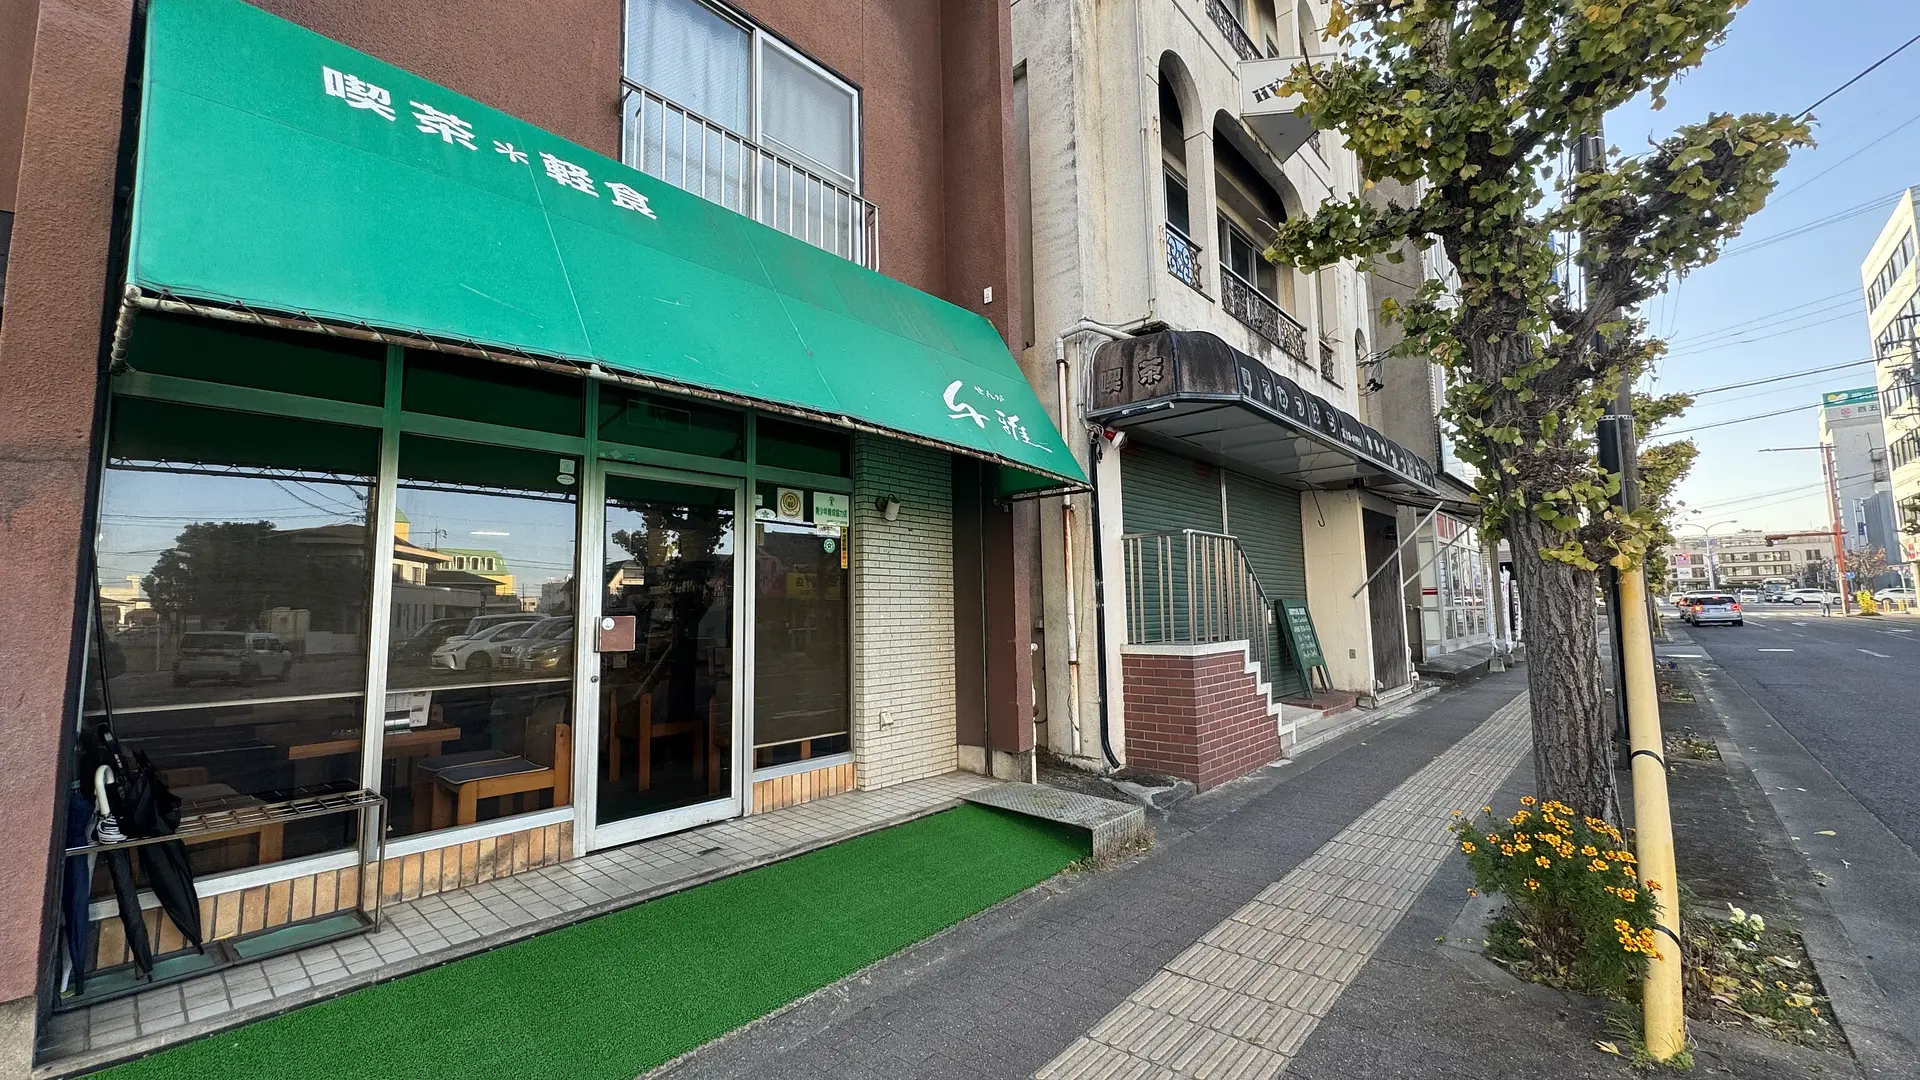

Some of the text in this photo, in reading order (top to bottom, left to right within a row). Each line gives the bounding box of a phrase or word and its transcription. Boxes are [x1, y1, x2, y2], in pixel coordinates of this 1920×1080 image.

[322, 65, 657, 220] 喫茶 軽食
[1101, 356, 1164, 394] 喫茶
